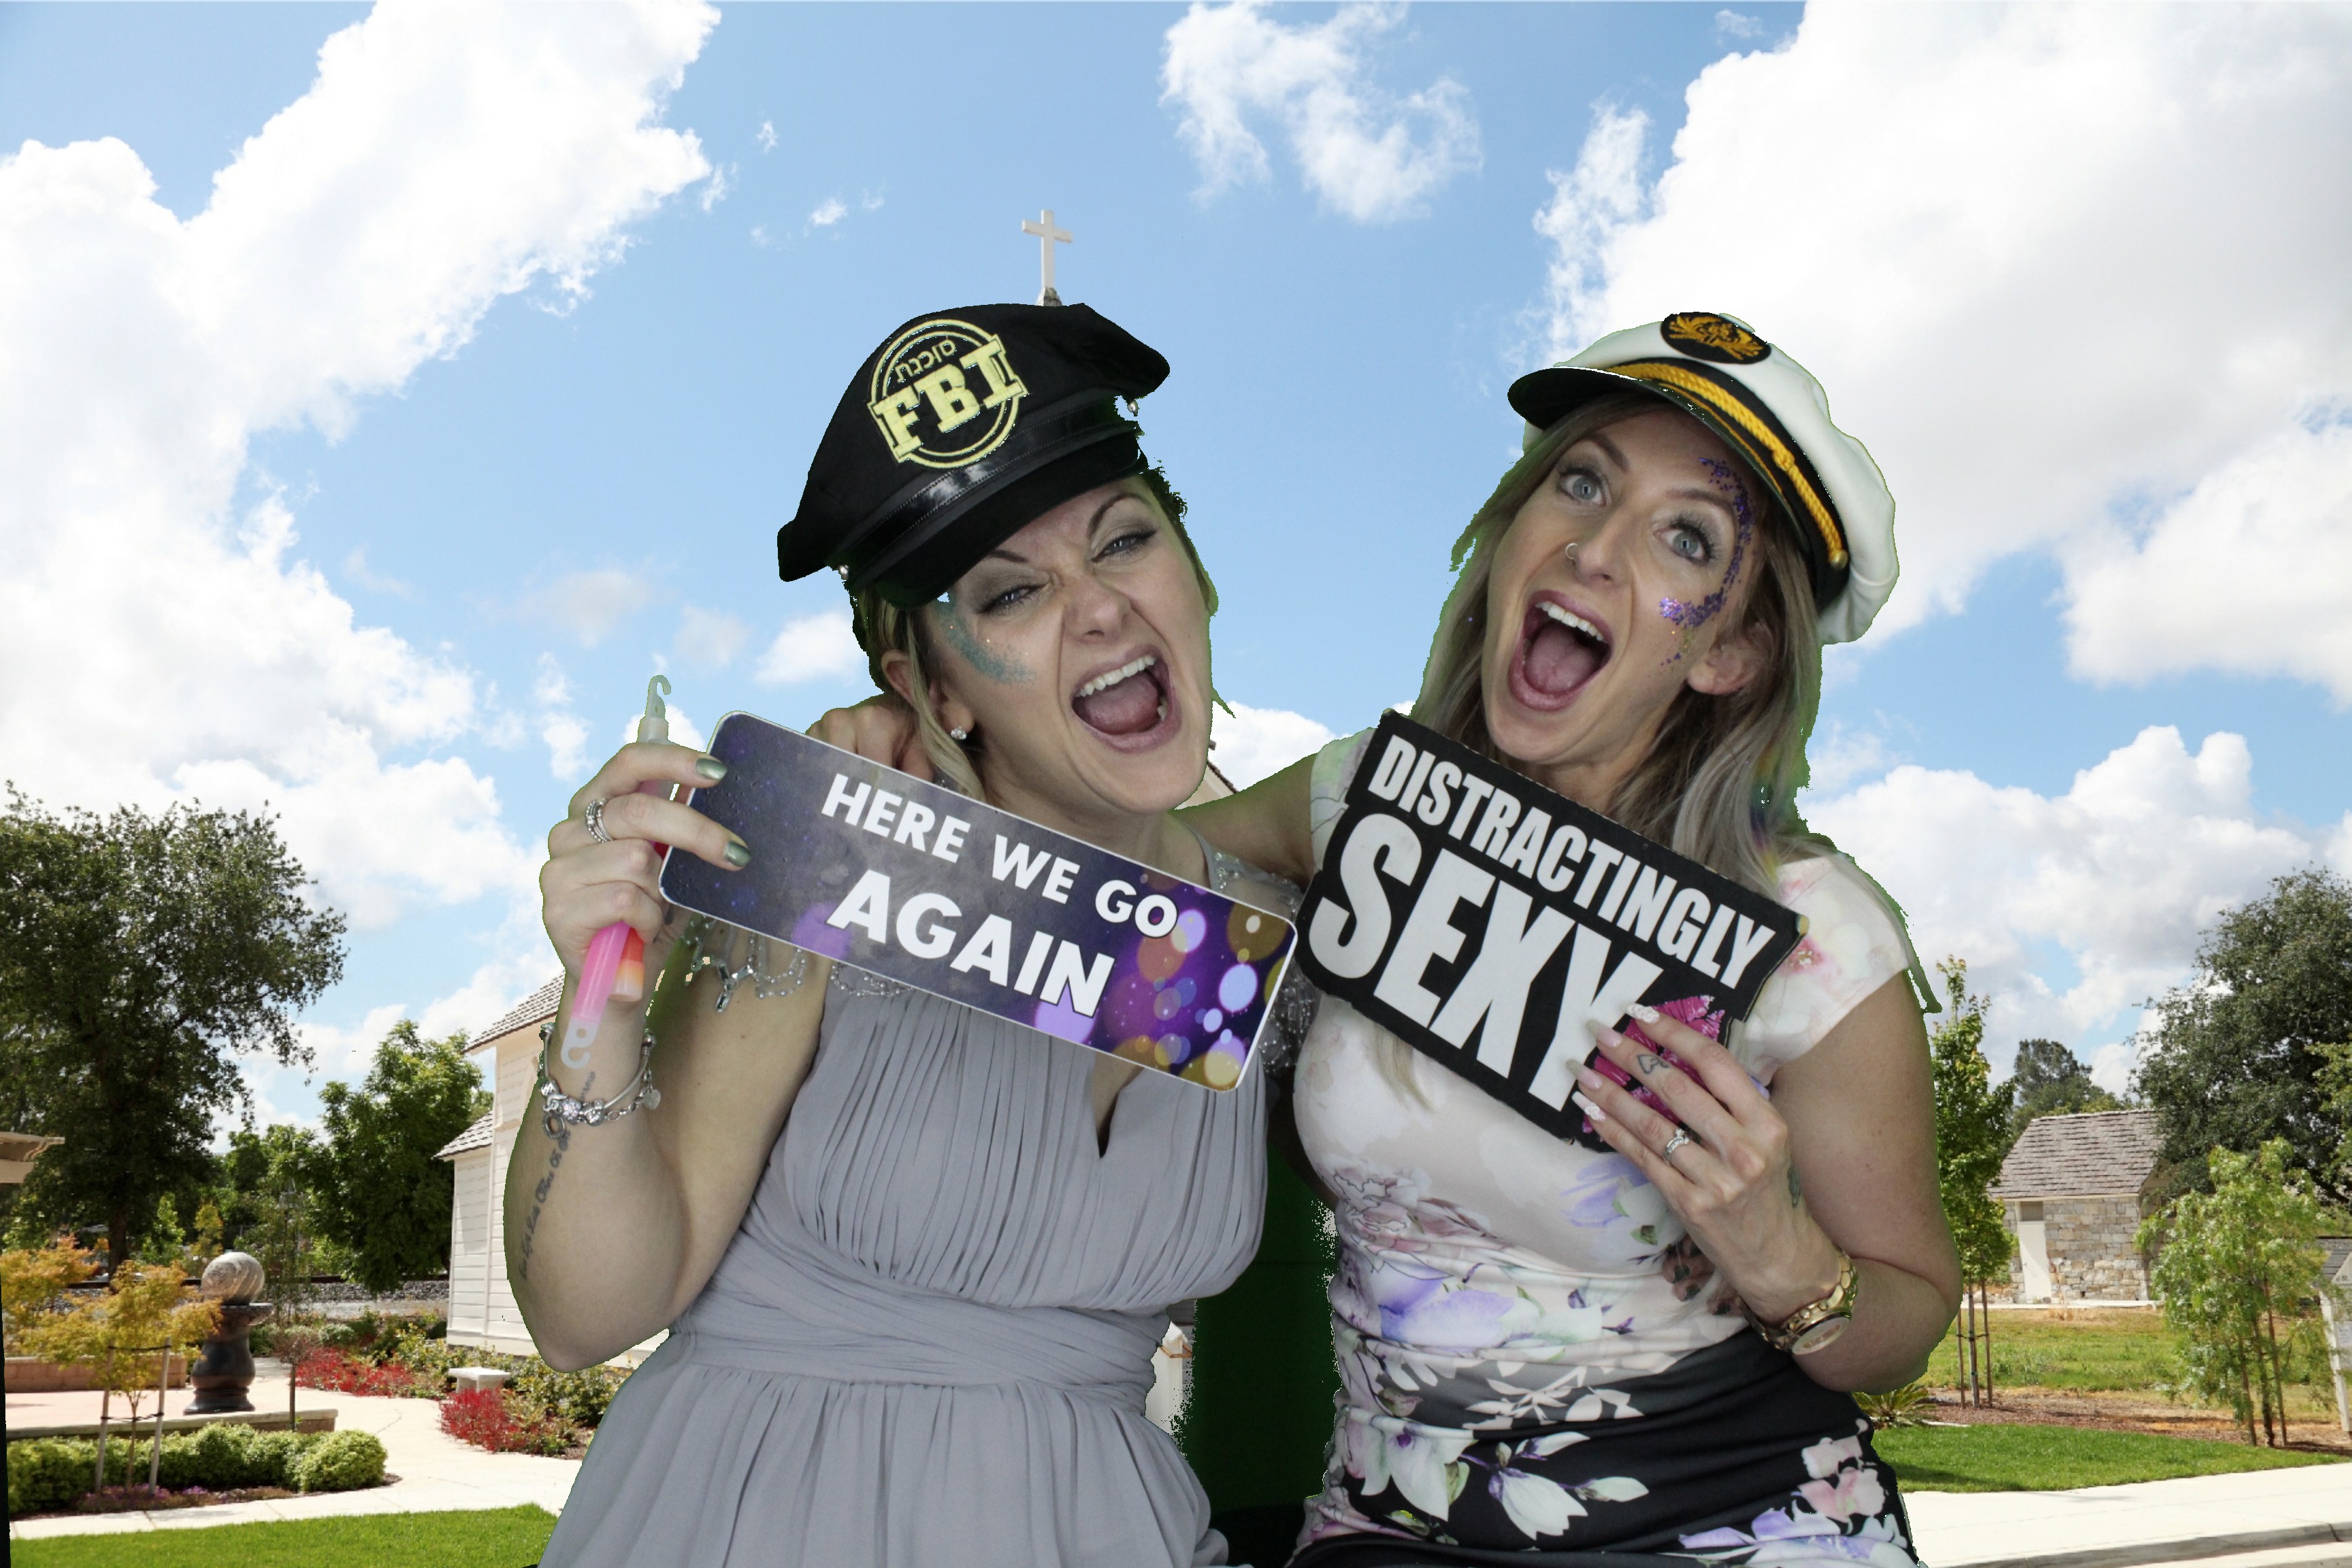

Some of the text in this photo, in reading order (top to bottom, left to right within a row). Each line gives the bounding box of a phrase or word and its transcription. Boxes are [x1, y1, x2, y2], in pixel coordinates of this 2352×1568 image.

[870, 337, 1026, 461] FBI
[894, 339, 956, 383] סוכנת
[821, 772, 1179, 938] HERE WE GO
[1367, 734, 1776, 990] DISTRACTINGLY
[826, 869, 1115, 1018] AGAIN
[1308, 813, 1663, 1111] SEXY
